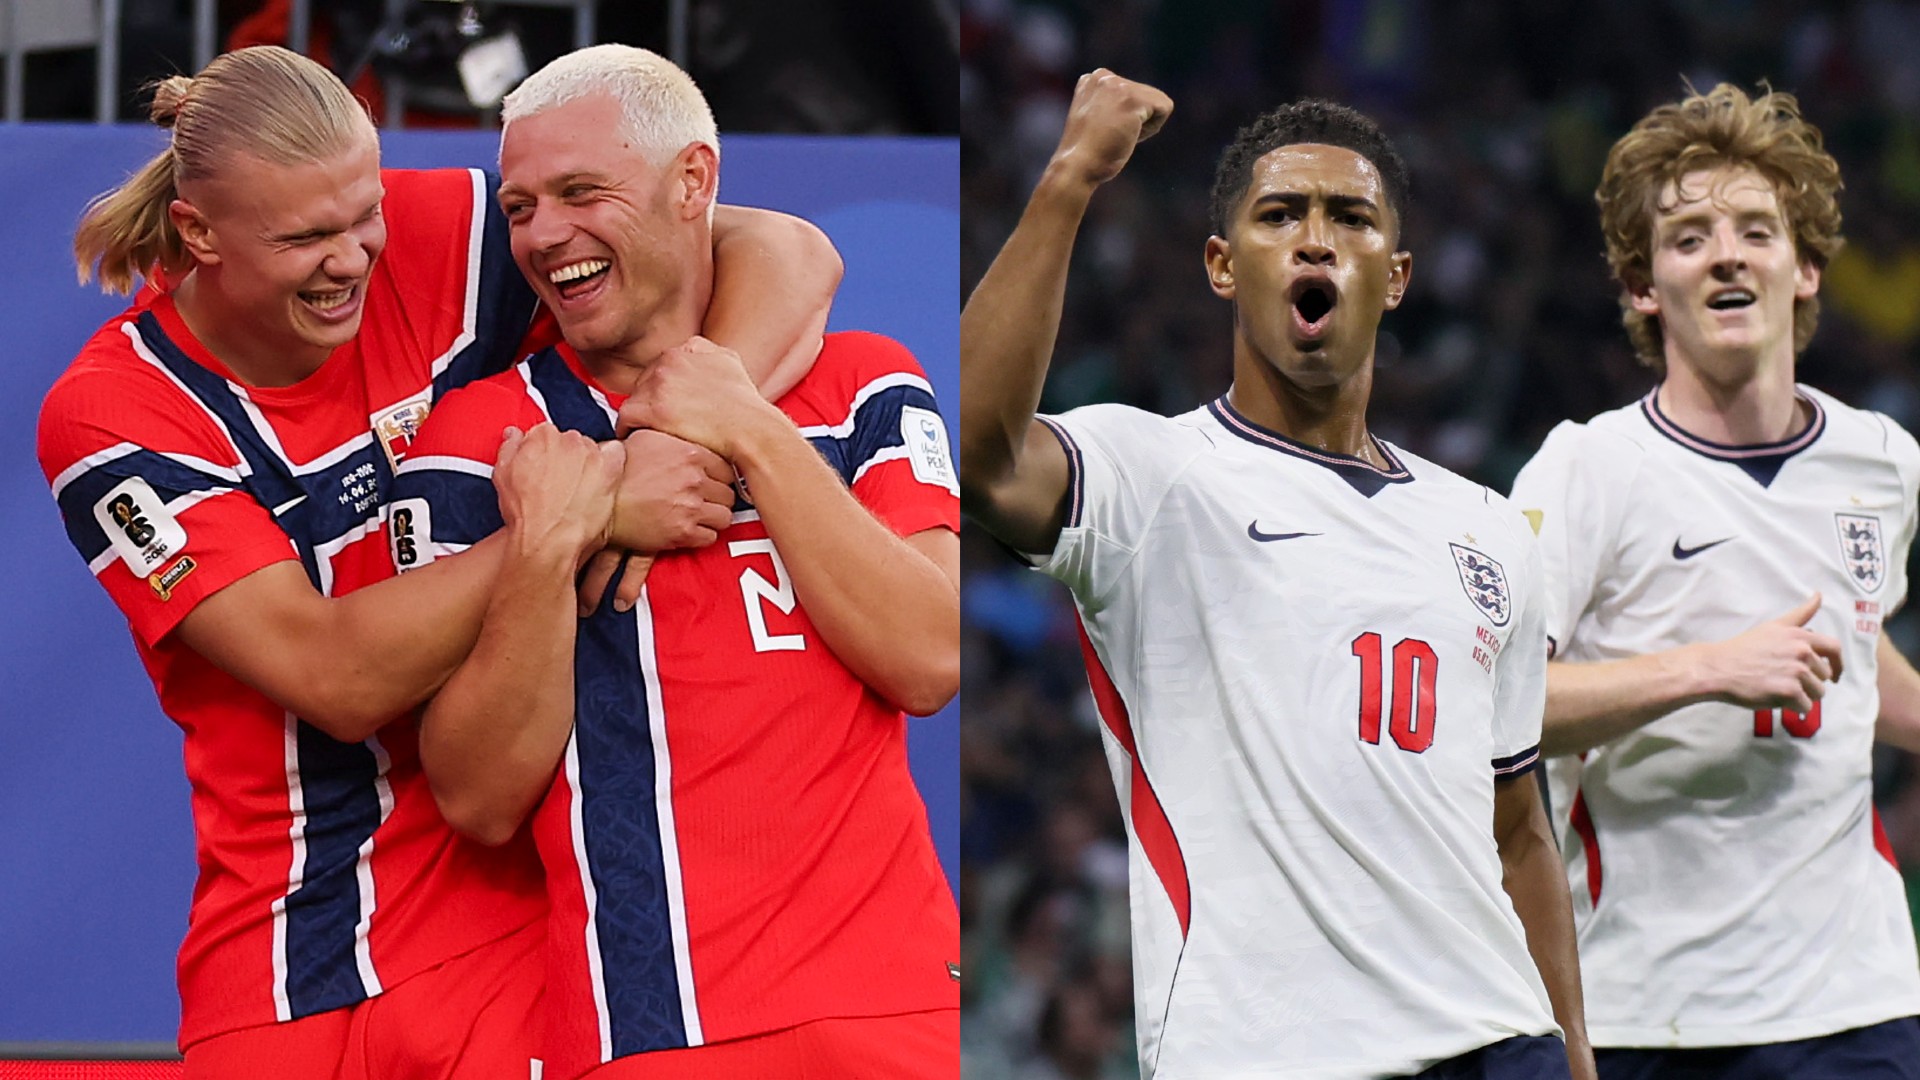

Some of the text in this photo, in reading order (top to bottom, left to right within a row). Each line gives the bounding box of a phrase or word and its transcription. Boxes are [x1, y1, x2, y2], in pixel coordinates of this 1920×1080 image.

[161, 559, 188, 585] DEBUT
[728, 538, 806, 652] 2
[1351, 631, 1439, 754] 10
